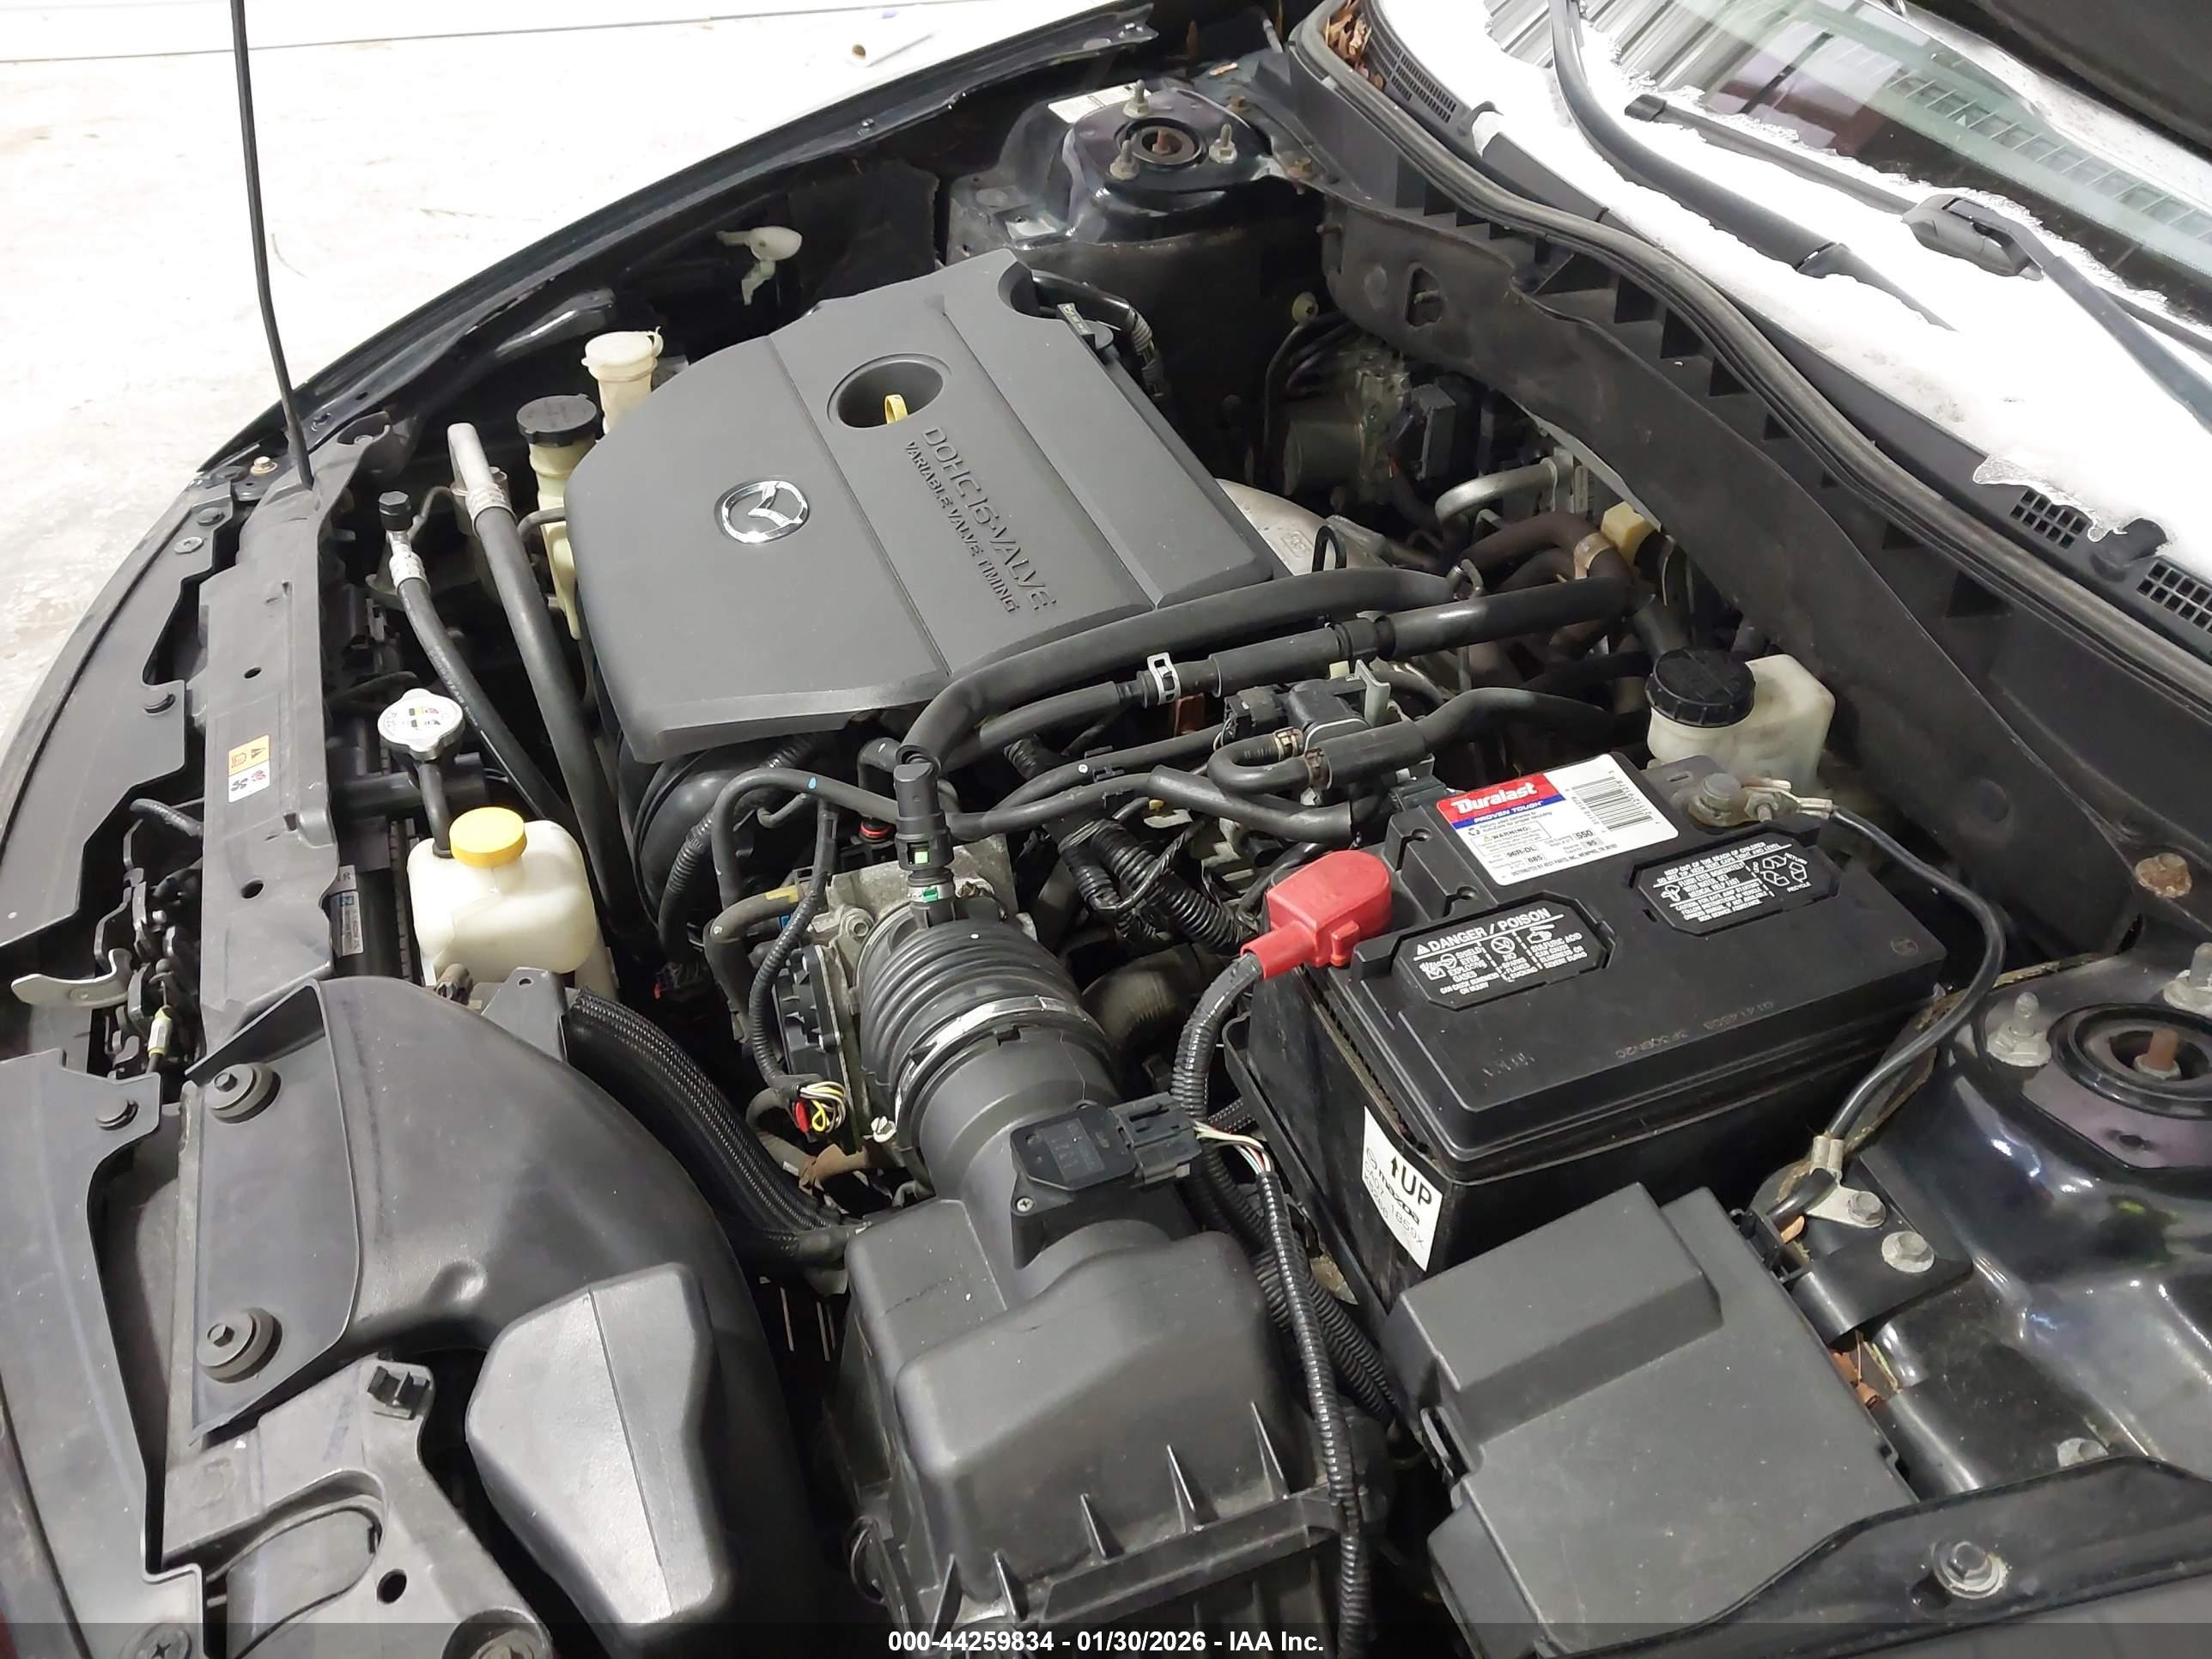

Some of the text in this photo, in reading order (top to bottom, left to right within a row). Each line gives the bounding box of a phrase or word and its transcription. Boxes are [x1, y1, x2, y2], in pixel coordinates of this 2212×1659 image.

[921, 426, 982, 498] DOHC
[905, 441, 1021, 613] VARIABLE VALVE TIMING
[1450, 782, 1537, 813] Duralast
[1474, 810, 1510, 823] PROVEN
[1576, 830, 1594, 839] 550
[1427, 927, 1487, 951] DANGER
[1497, 908, 1551, 931] POISON
[1401, 1164, 1433, 1206] UP
